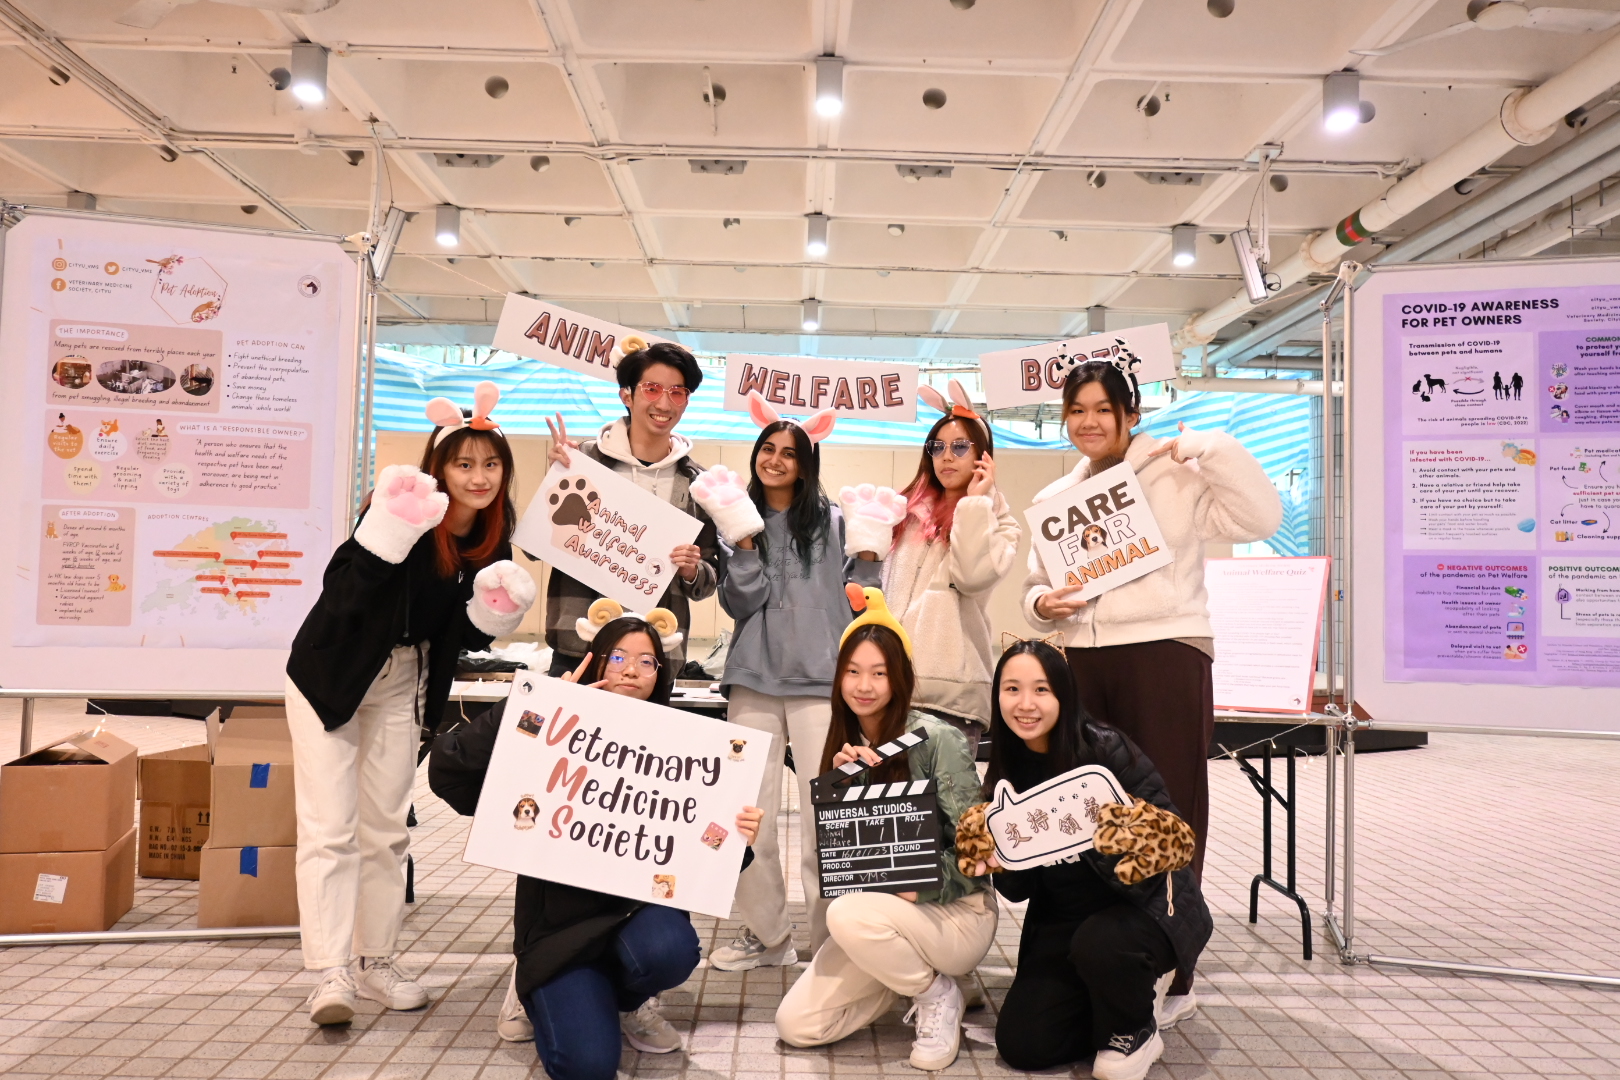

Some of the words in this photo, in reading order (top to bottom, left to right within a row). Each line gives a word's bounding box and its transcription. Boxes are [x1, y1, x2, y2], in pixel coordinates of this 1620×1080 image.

[161, 282, 176, 294] Pet
[179, 283, 219, 298] Adoption
[1402, 302, 1466, 314] COVID-19
[1471, 298, 1559, 312] AWARENESS
[1402, 318, 1428, 328] FOR
[1434, 317, 1457, 327] PET
[1462, 314, 1522, 326] OWNERS
[76, 328, 125, 338] IMPORTANCE
[524, 311, 615, 368] ANIM
[54, 341, 72, 350] Many
[74, 342, 87, 350] pets
[167, 348, 185, 356] places
[252, 340, 288, 348] ADOPTION
[279, 356, 302, 366] breeding
[233, 362, 256, 370] Prevent
[270, 367, 309, 375] overpopulation
[241, 373, 271, 381] abandoned
[232, 382, 246, 390] Save
[248, 385, 266, 393] money
[738, 363, 903, 409] WELFARE
[114, 396, 130, 404] illegal
[132, 396, 156, 406] breeding
[232, 392, 252, 402] Change
[264, 442, 275, 450] that
[228, 451, 249, 459] welfare
[241, 461, 253, 469] have
[243, 473, 258, 481] being
[1041, 481, 1135, 541] CARE
[587, 498, 647, 542] Animal
[578, 518, 646, 564] Welfare
[564, 534, 658, 595] Awareness
[1065, 537, 1159, 586] ANIMAL
[1286, 569, 1307, 577] Quiz
[546, 707, 721, 786] Veterinary
[546, 757, 696, 823] Medicine
[819, 806, 869, 820] UNIVERSAL
[825, 822, 849, 830] SCENE
[866, 818, 885, 827] TAKE
[905, 814, 925, 822] ROLL
[549, 805, 674, 865] Society
[893, 844, 921, 852] SOUND
[822, 862, 853, 870] PROD.CO.
[859, 872, 888, 882] VMS
